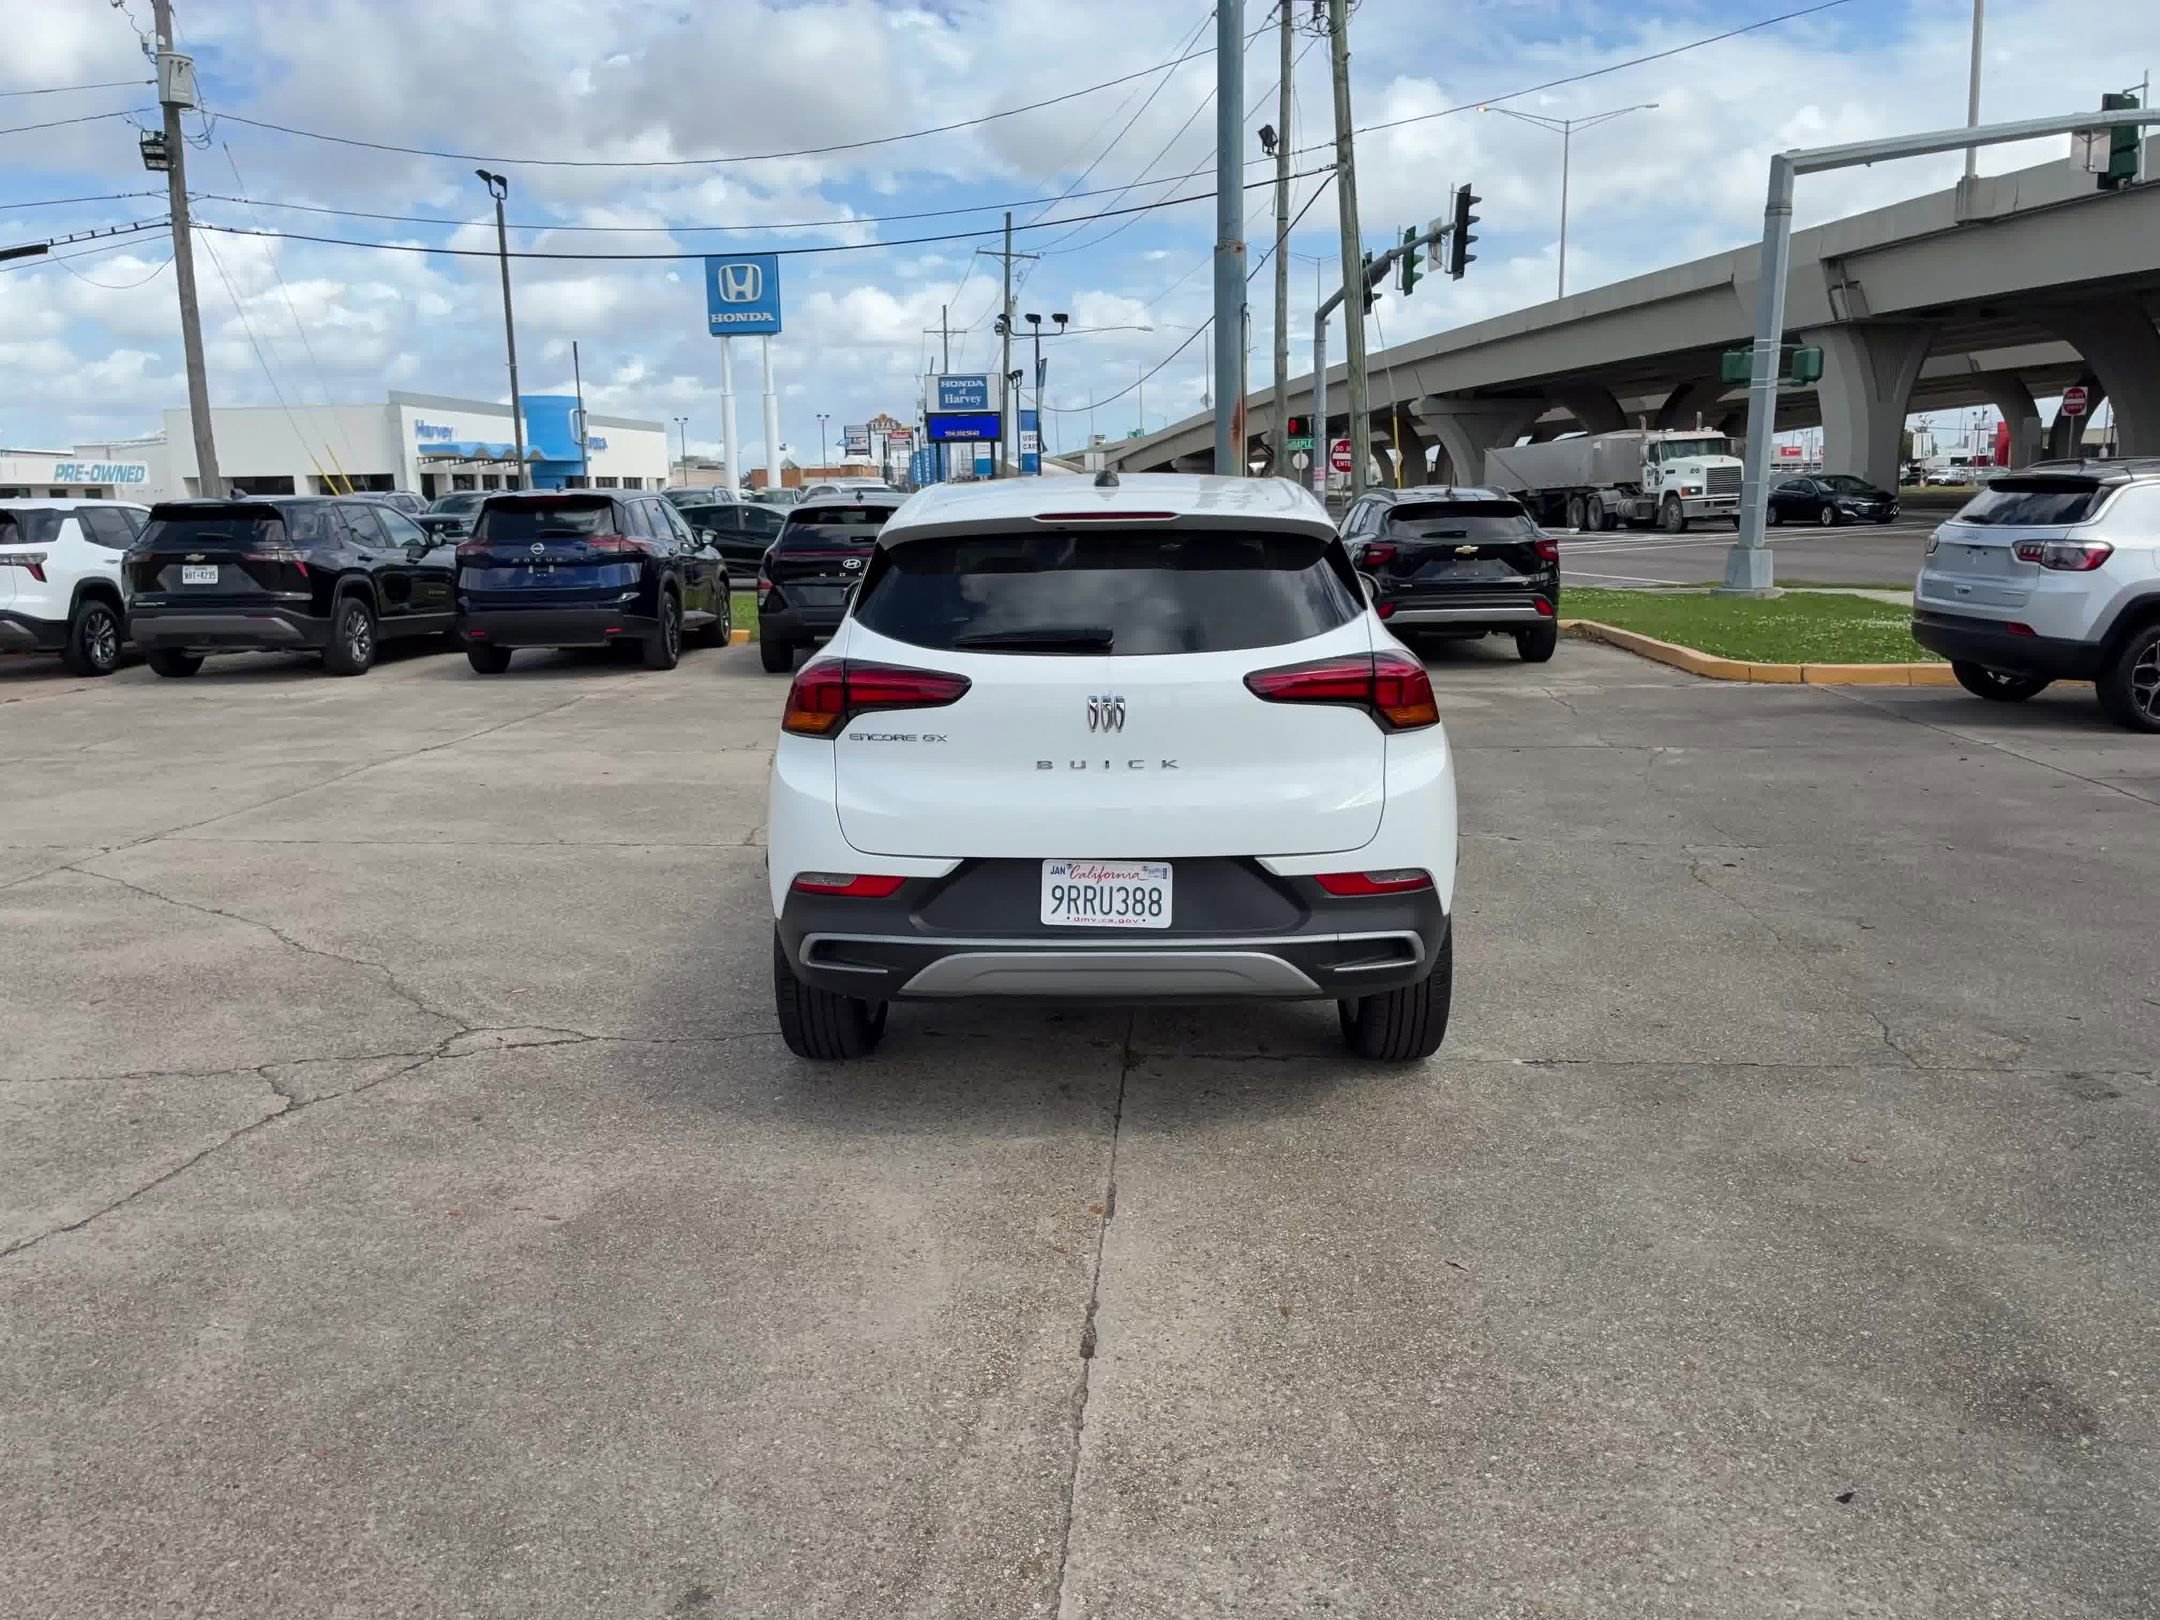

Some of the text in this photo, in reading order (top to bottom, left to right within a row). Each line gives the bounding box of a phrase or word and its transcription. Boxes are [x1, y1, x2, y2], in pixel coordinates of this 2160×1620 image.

[711, 312, 776, 323] HONDA
[944, 394, 982, 405] Harvey
[415, 419, 453, 441] Harvey
[870, 421, 897, 429] TEXAS
[54, 464, 145, 483] PRE-OWNED
[849, 733, 948, 742] ENCORE GX
[1036, 759, 1179, 770] BUICK
[1050, 865, 1066, 875] JAN
[1069, 864, 1149, 884] California
[1051, 884, 1163, 917] 9RRU388
